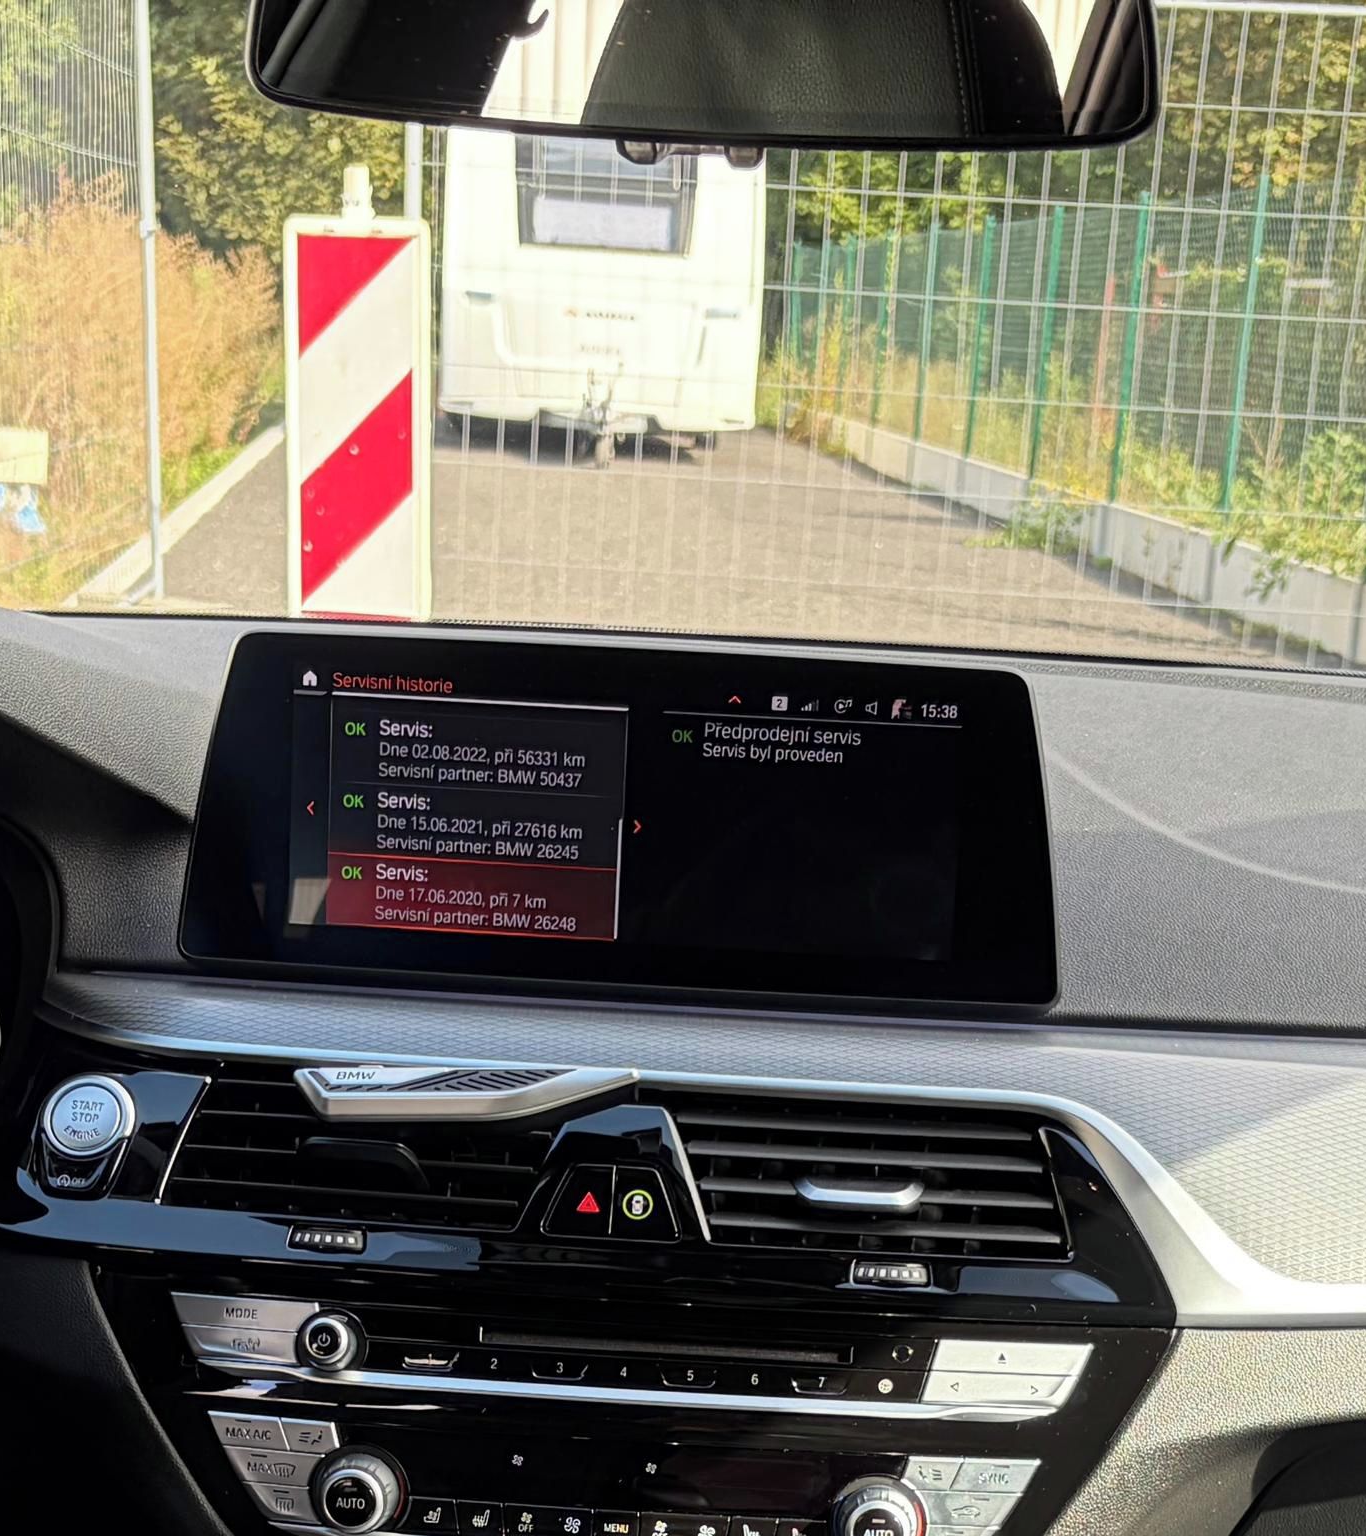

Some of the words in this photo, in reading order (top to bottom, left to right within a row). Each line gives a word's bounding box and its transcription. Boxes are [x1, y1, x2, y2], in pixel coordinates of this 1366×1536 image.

[332, 672, 393, 691] Servisní
[396, 676, 453, 694] historie
[920, 703, 958, 719] 15:38
[344, 721, 367, 737] OK
[379, 719, 434, 739] Servis:
[671, 729, 694, 743] OK
[704, 721, 811, 744] Předprodejní
[813, 729, 862, 746] servis
[378, 741, 409, 758] Dne
[411, 744, 491, 766] 02.08.2022,
[494, 749, 514, 767] při
[517, 749, 559, 767] 56331
[563, 751, 586, 767] km
[702, 742, 747, 759] Servis
[749, 744, 771, 763] byl
[774, 746, 844, 764] proveden
[378, 762, 435, 780] Servisní
[438, 766, 494, 784] partner:
[497, 768, 537, 786] BMW
[539, 770, 582, 788] 50437
[342, 794, 364, 809] OK
[377, 791, 431, 811] Servis:
[377, 813, 407, 830] Dne
[410, 815, 488, 838] 15.06.2021,
[491, 821, 512, 839] při
[514, 822, 557, 839] 27616
[560, 823, 583, 840] km
[376, 834, 433, 852] Servisní
[435, 838, 492, 857] partner:
[495, 840, 534, 857] BMW
[536, 843, 579, 861] 26245
[341, 865, 363, 881] OK
[375, 863, 429, 882] Servis:
[375, 885, 405, 901] Dne
[410, 887, 485, 909] 17.06.2020,
[489, 891, 509, 910] při
[511, 893, 522, 909] 7
[524, 895, 547, 910] km
[374, 906, 431, 923] Servisní
[433, 909, 489, 929] partner:
[492, 913, 531, 930] BMW
[534, 915, 577, 932] 26248
[335, 1070, 376, 1081] BMW
[71, 1099, 106, 1112] START
[71, 1111, 100, 1123] STOP
[63, 1125, 101, 1142] ENGINE
[224, 1306, 259, 1320] MODE
[490, 1356, 499, 1371] 2
[556, 1360, 565, 1375] 3
[619, 1365, 628, 1379] 4
[686, 1369, 695, 1383] 5
[750, 1373, 760, 1387] 6
[818, 1376, 826, 1390] 7
[225, 1426, 252, 1441] MAX
[252, 1428, 272, 1442] A/C
[246, 1460, 273, 1475] MAX
[977, 1471, 1010, 1485] SYNC
[335, 1496, 366, 1511] AUTO
[517, 1522, 535, 1533] OFF
[603, 1521, 629, 1535] MENU
